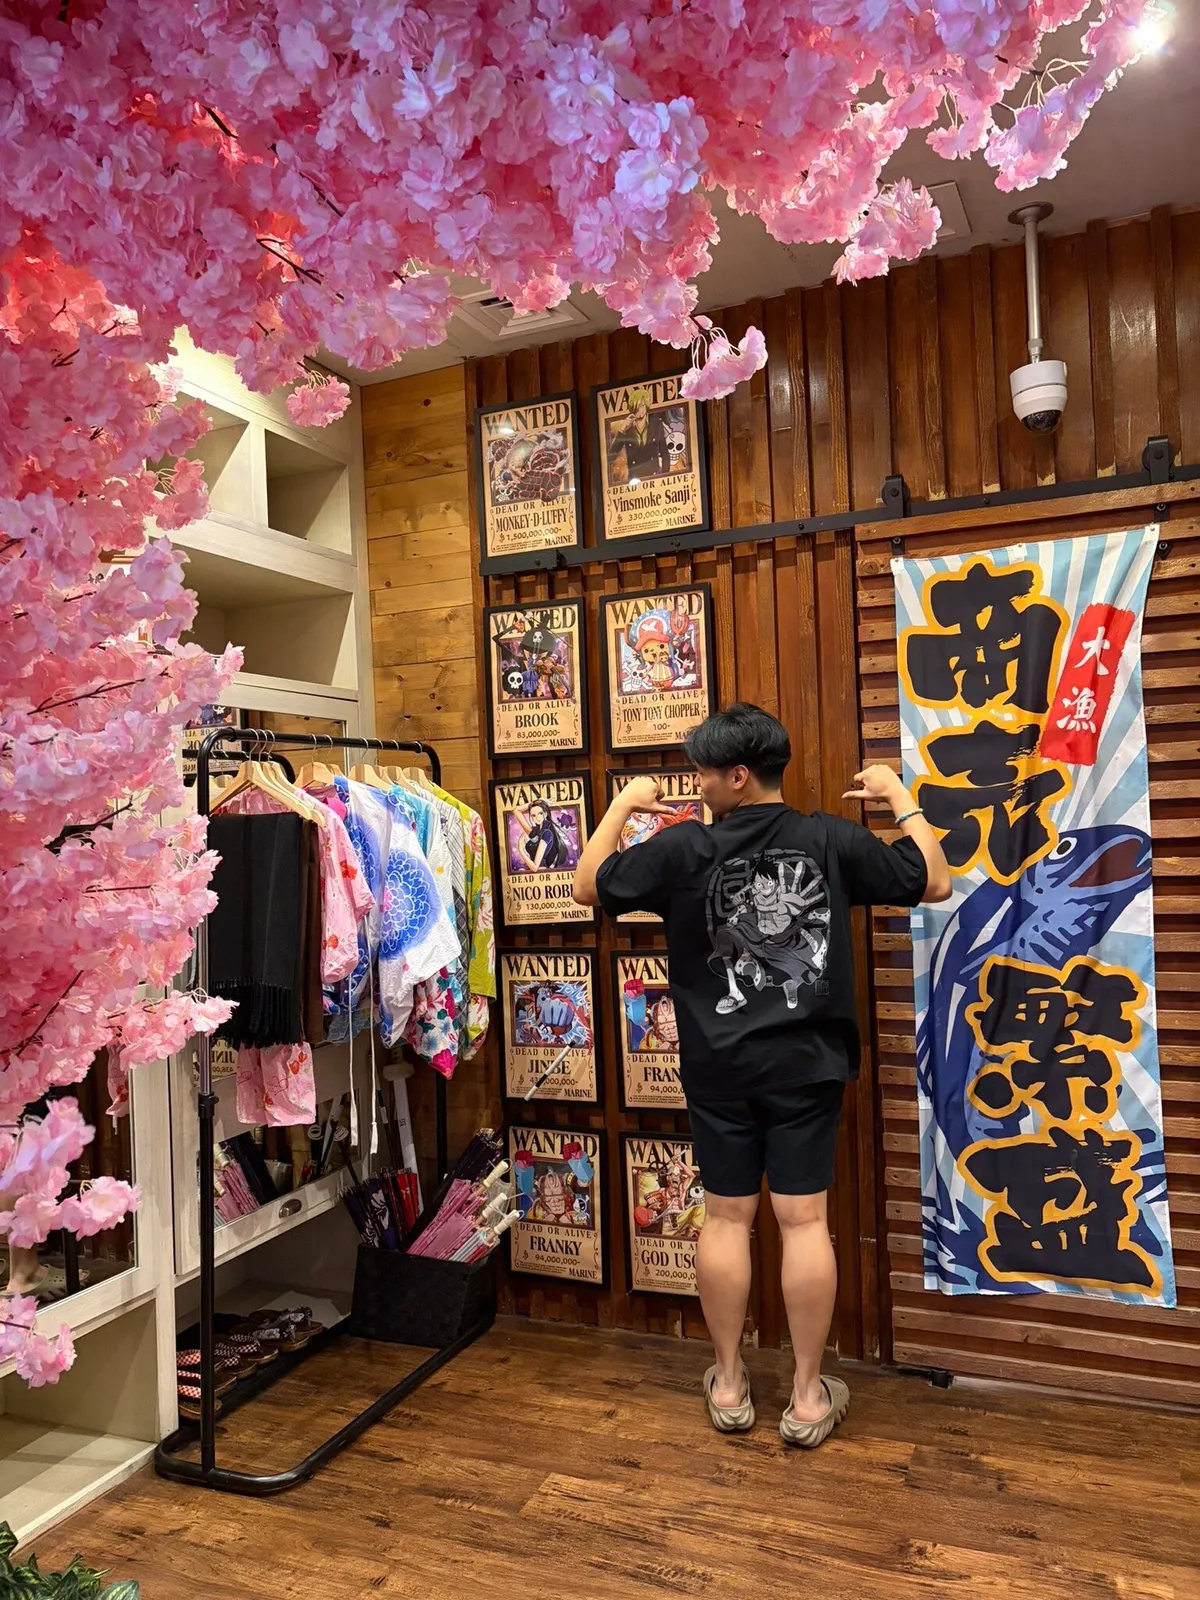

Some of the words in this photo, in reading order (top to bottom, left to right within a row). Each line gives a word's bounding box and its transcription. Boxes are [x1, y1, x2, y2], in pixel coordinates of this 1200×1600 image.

[484, 403, 569, 436] WANTED
[612, 484, 637, 494] DEAD
[643, 480, 655, 490] OR
[660, 474, 688, 486] ALIVE
[495, 505, 518, 514] DEAD
[524, 502, 535, 510] OR
[540, 496, 567, 507] ALIVE
[613, 491, 662, 513] Vinsmoke
[665, 485, 690, 505] Sanji
[666, 514, 696, 527] MARINE
[545, 535, 573, 546] MARINE
[1056, 626, 1110, 734] 大漁
[622, 696, 646, 704] DEAD
[670, 690, 699, 700] ALIVE
[502, 704, 524, 712] DEAD
[529, 702, 540, 710] OR
[545, 700, 572, 708] ALIVE
[622, 707, 642, 722] TONY
[643, 706, 664, 720] TONY
[665, 703, 700, 719] CHOPPER
[515, 712, 559, 728] BROOK
[550, 738, 577, 747] MARINE
[498, 780, 582, 808] WANTED
[556, 872, 576, 881] ALIV
[512, 885, 541, 901] NICO
[545, 884, 573, 899] ROBI
[561, 910, 589, 919] MARINE
[505, 956, 590, 977] WANTED
[619, 959, 668, 980] WAN
[516, 1048, 538, 1056] DEAD
[544, 1048, 555, 1056] OR
[632, 1055, 657, 1063] DEAD
[663, 1055, 676, 1063] OR
[644, 1067, 681, 1082] FRAN
[564, 1089, 592, 1098] MARINE
[628, 1140, 698, 1166] WANT
[520, 1223, 543, 1233] DEAD
[548, 1226, 560, 1235] OR
[565, 1228, 592, 1239] ALIVE
[530, 1235, 582, 1256] FRANKY
[640, 1238, 664, 1248] DEAD
[670, 1241, 683, 1249] OR
[641, 1250, 669, 1266] GOD
[569, 1268, 598, 1280] MARINE
